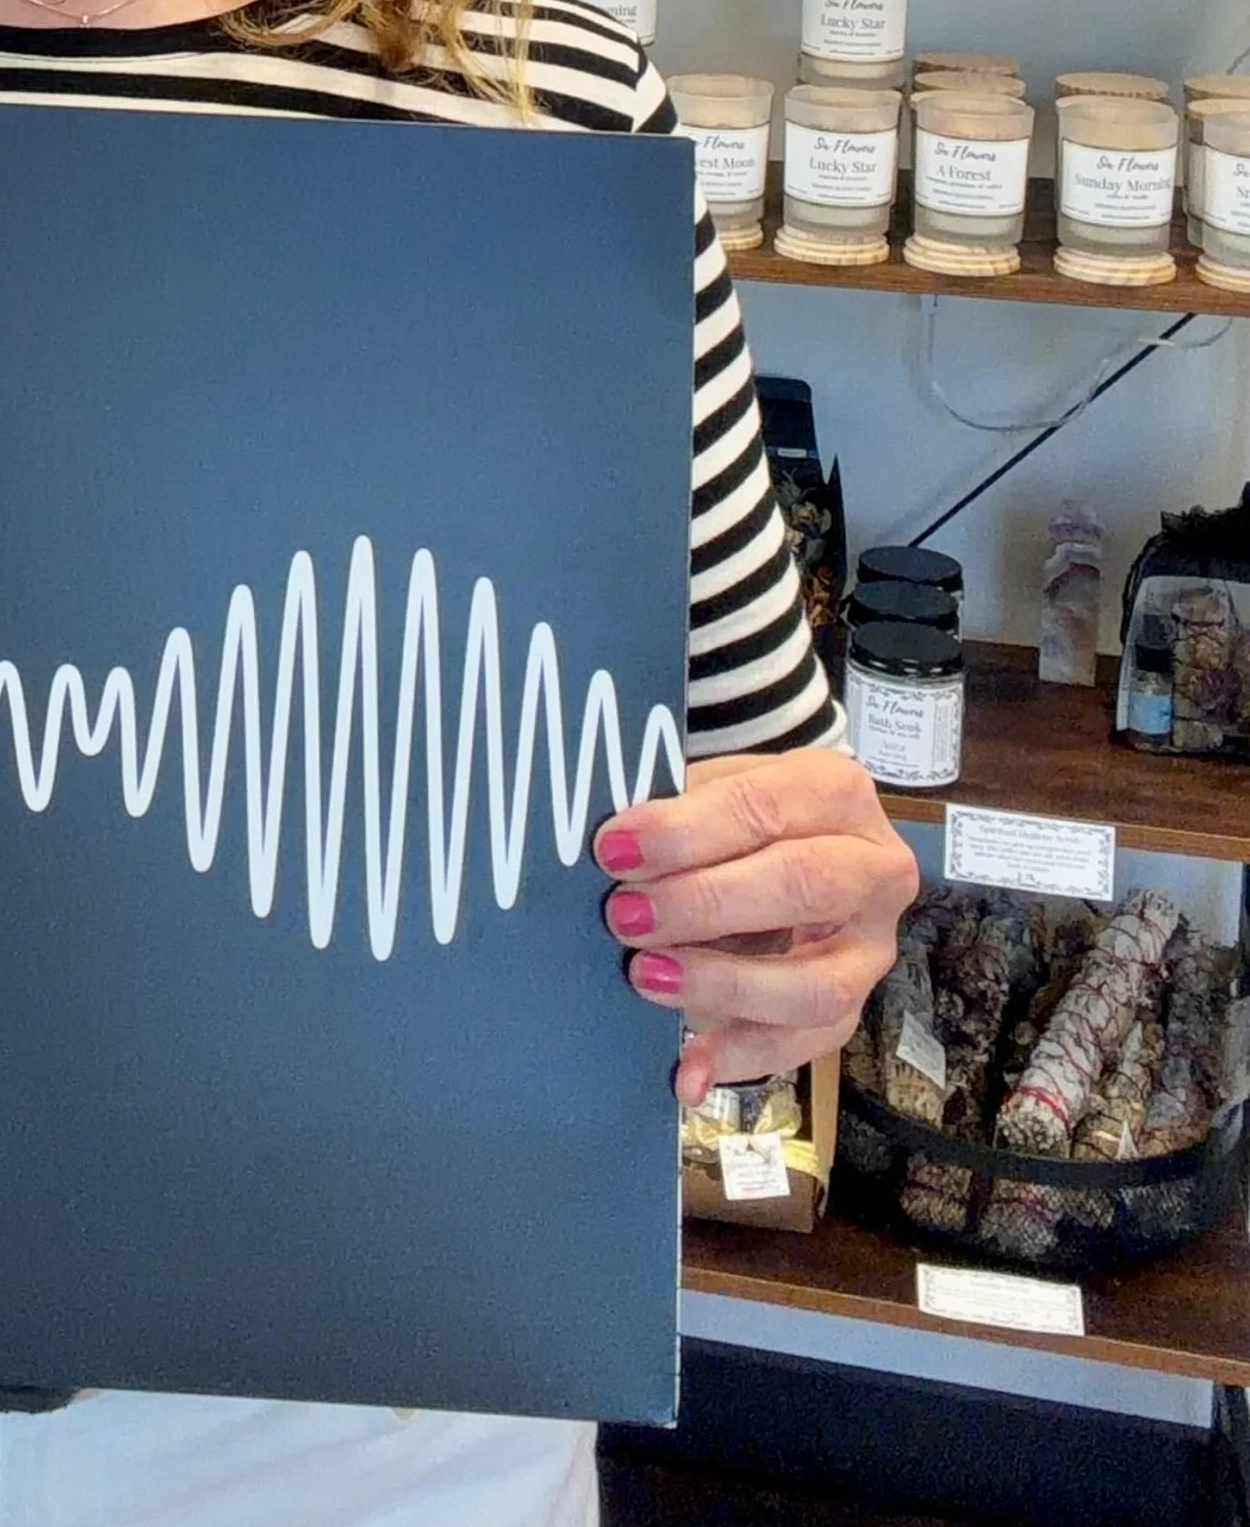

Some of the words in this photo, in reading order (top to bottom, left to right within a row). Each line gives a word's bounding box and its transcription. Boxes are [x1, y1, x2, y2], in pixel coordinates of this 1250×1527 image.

[821, 13, 856, 32] Lucky
[861, 17, 887, 30] Star
[703, 135, 746, 150] Flowers
[833, 138, 876, 154] Flowers
[951, 145, 997, 162] Flowers
[810, 156, 847, 176] Lucky
[852, 161, 878, 173] Star
[1117, 157, 1160, 172] Flowers
[949, 166, 992, 182] Forest
[1075, 174, 1123, 195] Sunday
[882, 700, 924, 718] Flowers
[868, 713, 892, 729] Bath
